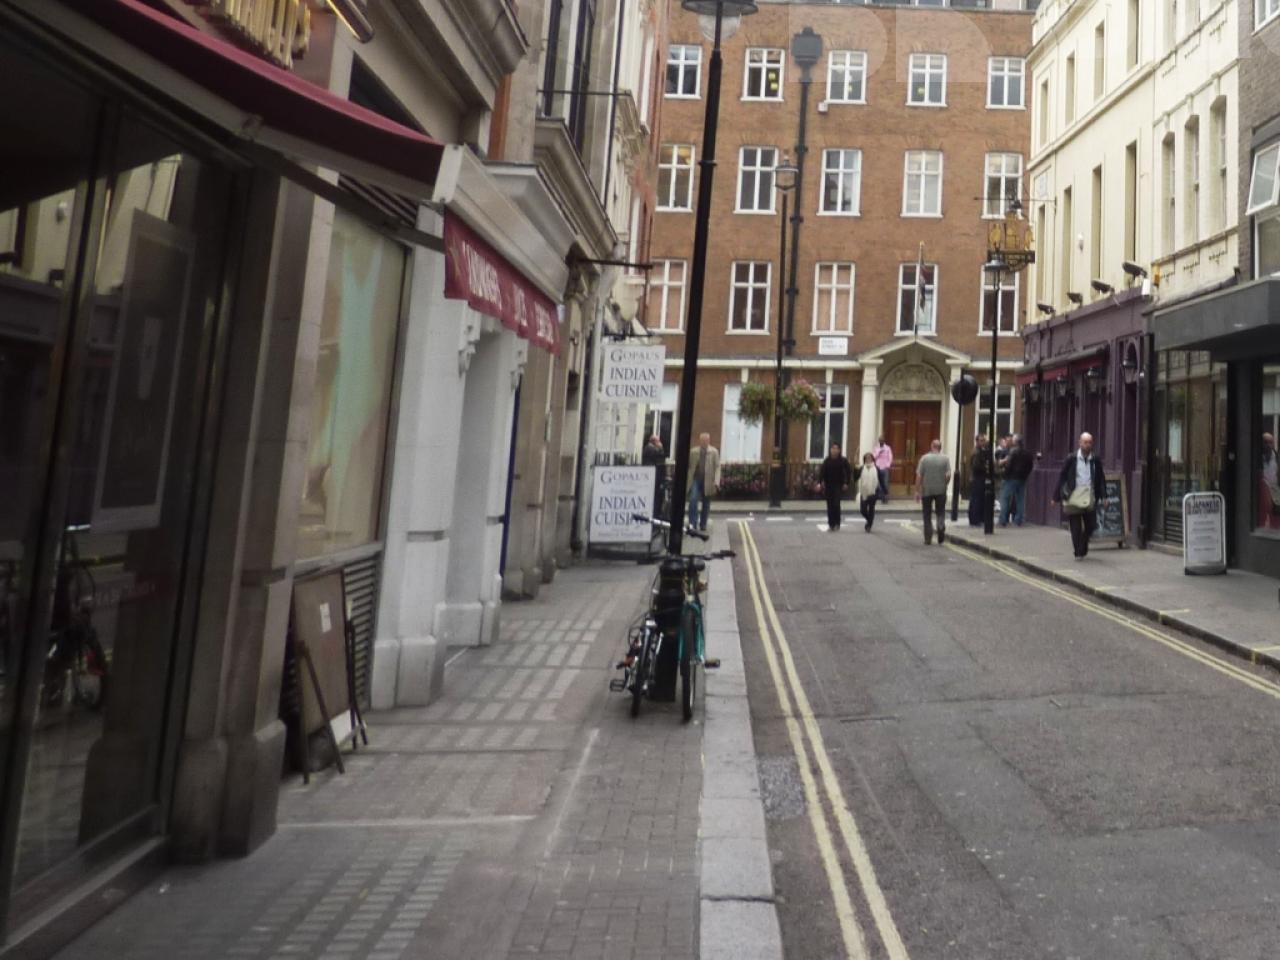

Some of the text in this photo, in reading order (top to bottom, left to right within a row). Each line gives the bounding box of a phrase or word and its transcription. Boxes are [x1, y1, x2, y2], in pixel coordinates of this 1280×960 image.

[610, 367, 657, 381] INDIAN
[605, 384, 657, 398] CUISINE
[599, 496, 647, 510] INDIAN
